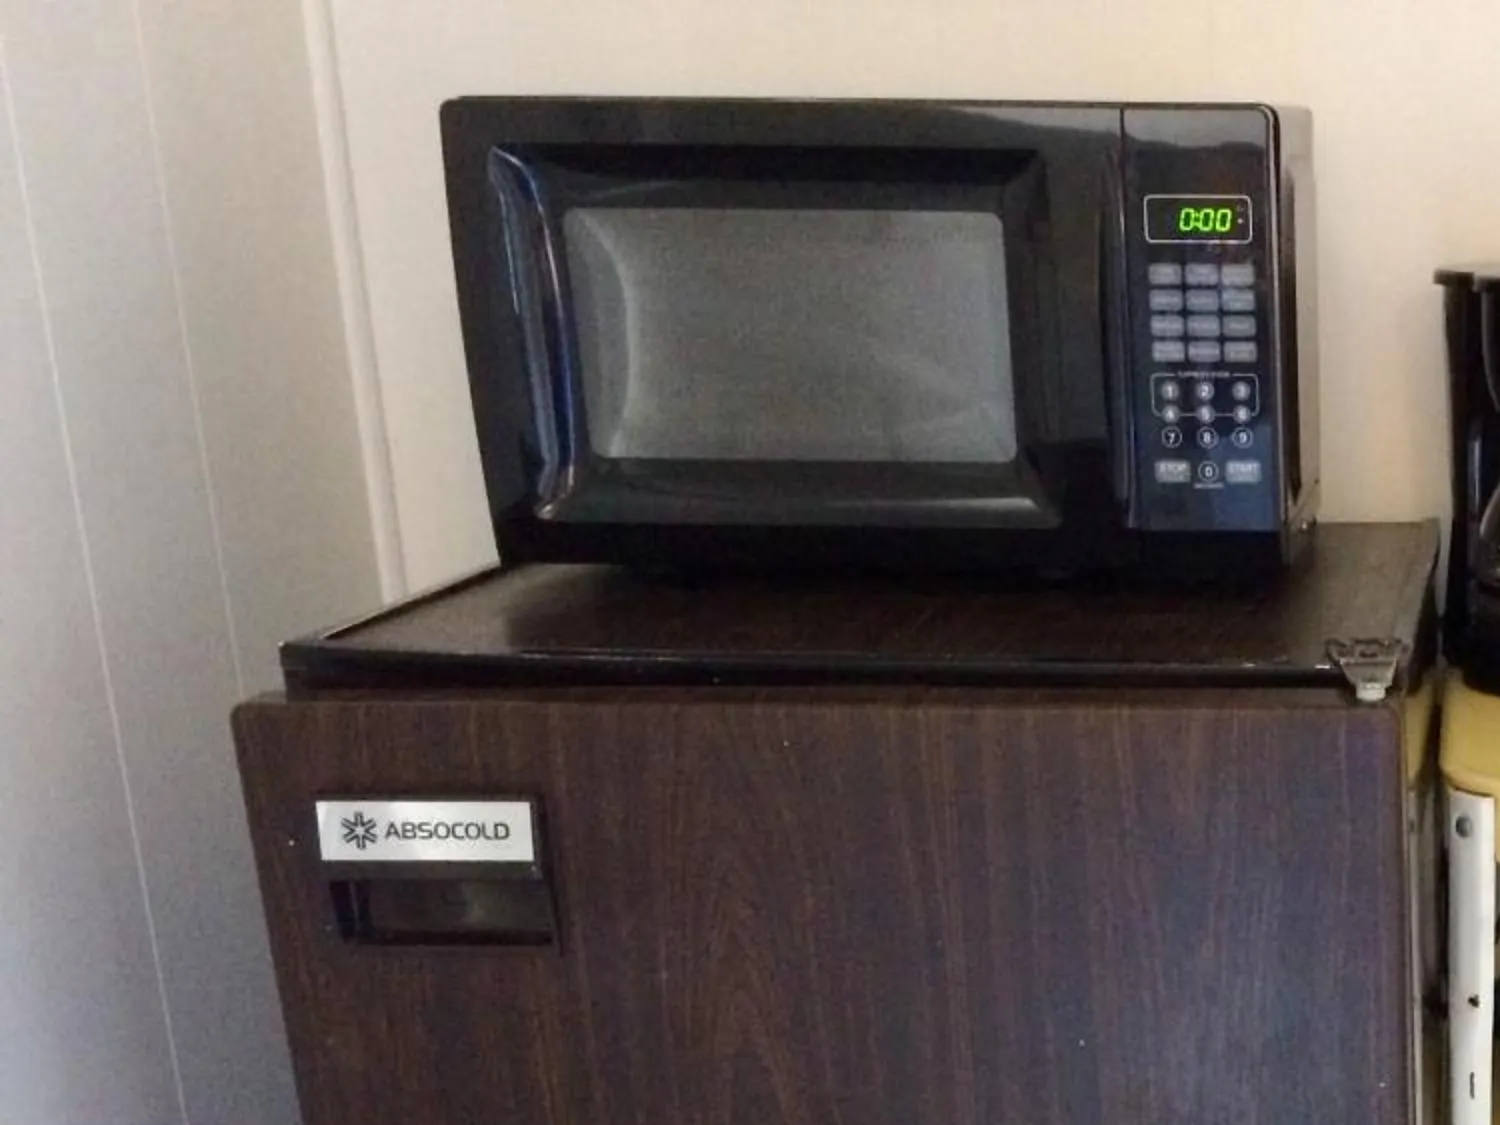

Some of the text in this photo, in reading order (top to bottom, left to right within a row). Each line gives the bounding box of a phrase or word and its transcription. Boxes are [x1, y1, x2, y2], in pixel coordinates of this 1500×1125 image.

[1179, 208, 1232, 232] 0:00
[1159, 462, 1186, 474] STOP
[1228, 462, 1258, 474] START
[384, 822, 510, 841] ABSOCOLD
